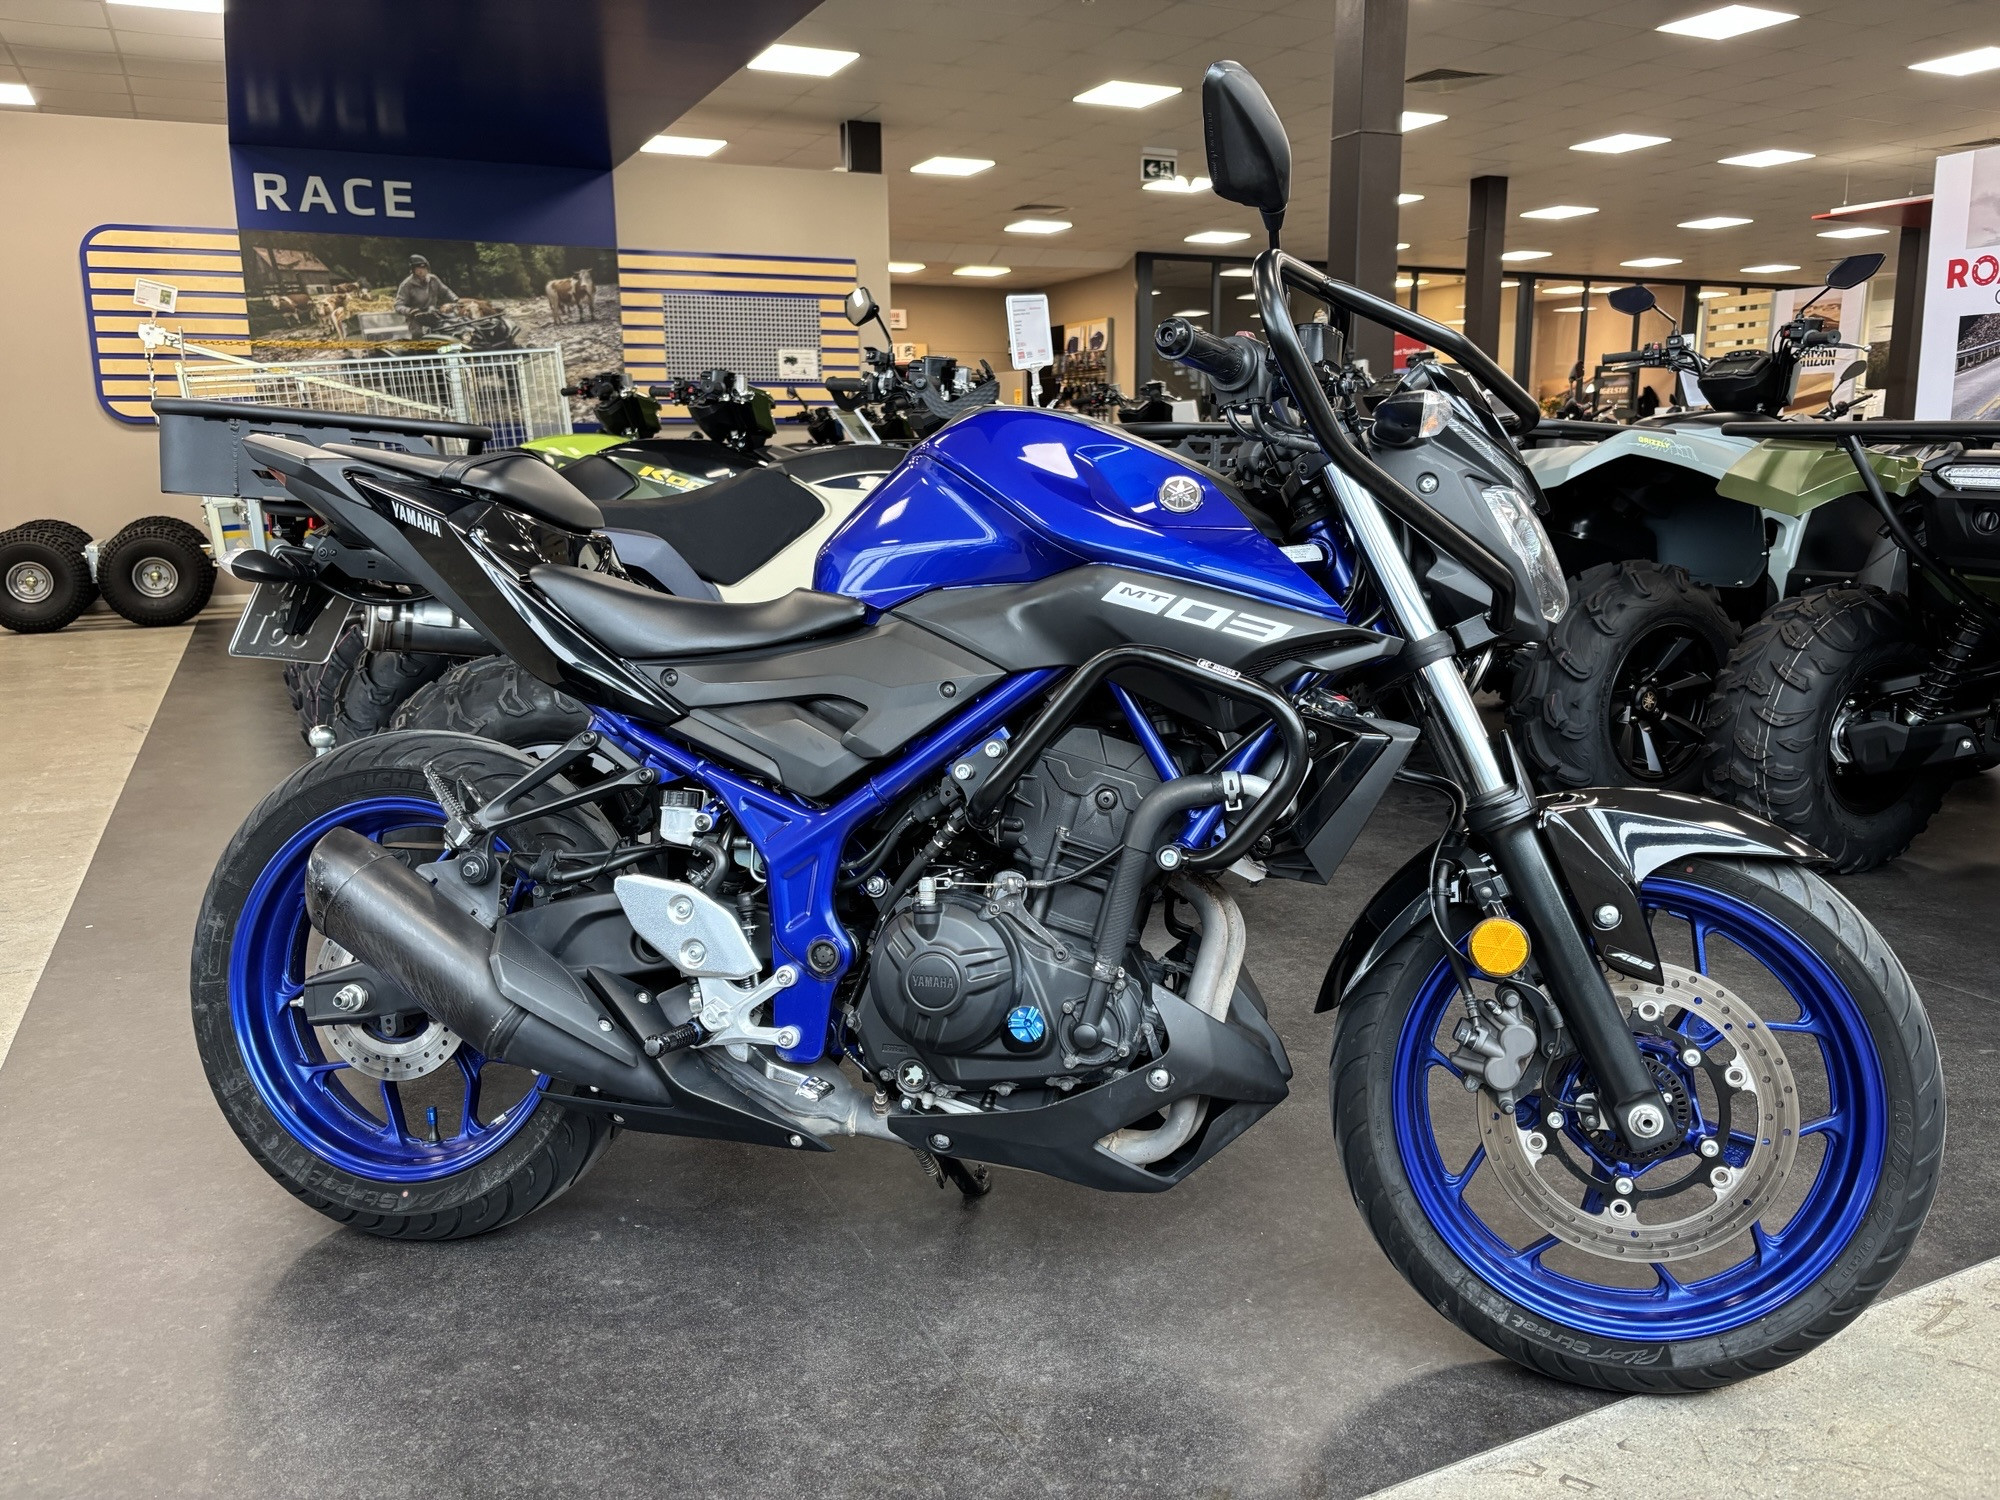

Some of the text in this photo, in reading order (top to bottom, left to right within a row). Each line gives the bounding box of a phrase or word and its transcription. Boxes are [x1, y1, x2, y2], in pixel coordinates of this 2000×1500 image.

[253, 172, 415, 218] RACE
[1946, 254, 2000, 289] RO
[1638, 436, 1671, 448] GRIZZLY
[391, 500, 442, 538] YAMAHA
[1118, 586, 1295, 642] MT 03
[1606, 952, 1657, 970] ABS
[912, 975, 954, 989] YAMAHA
